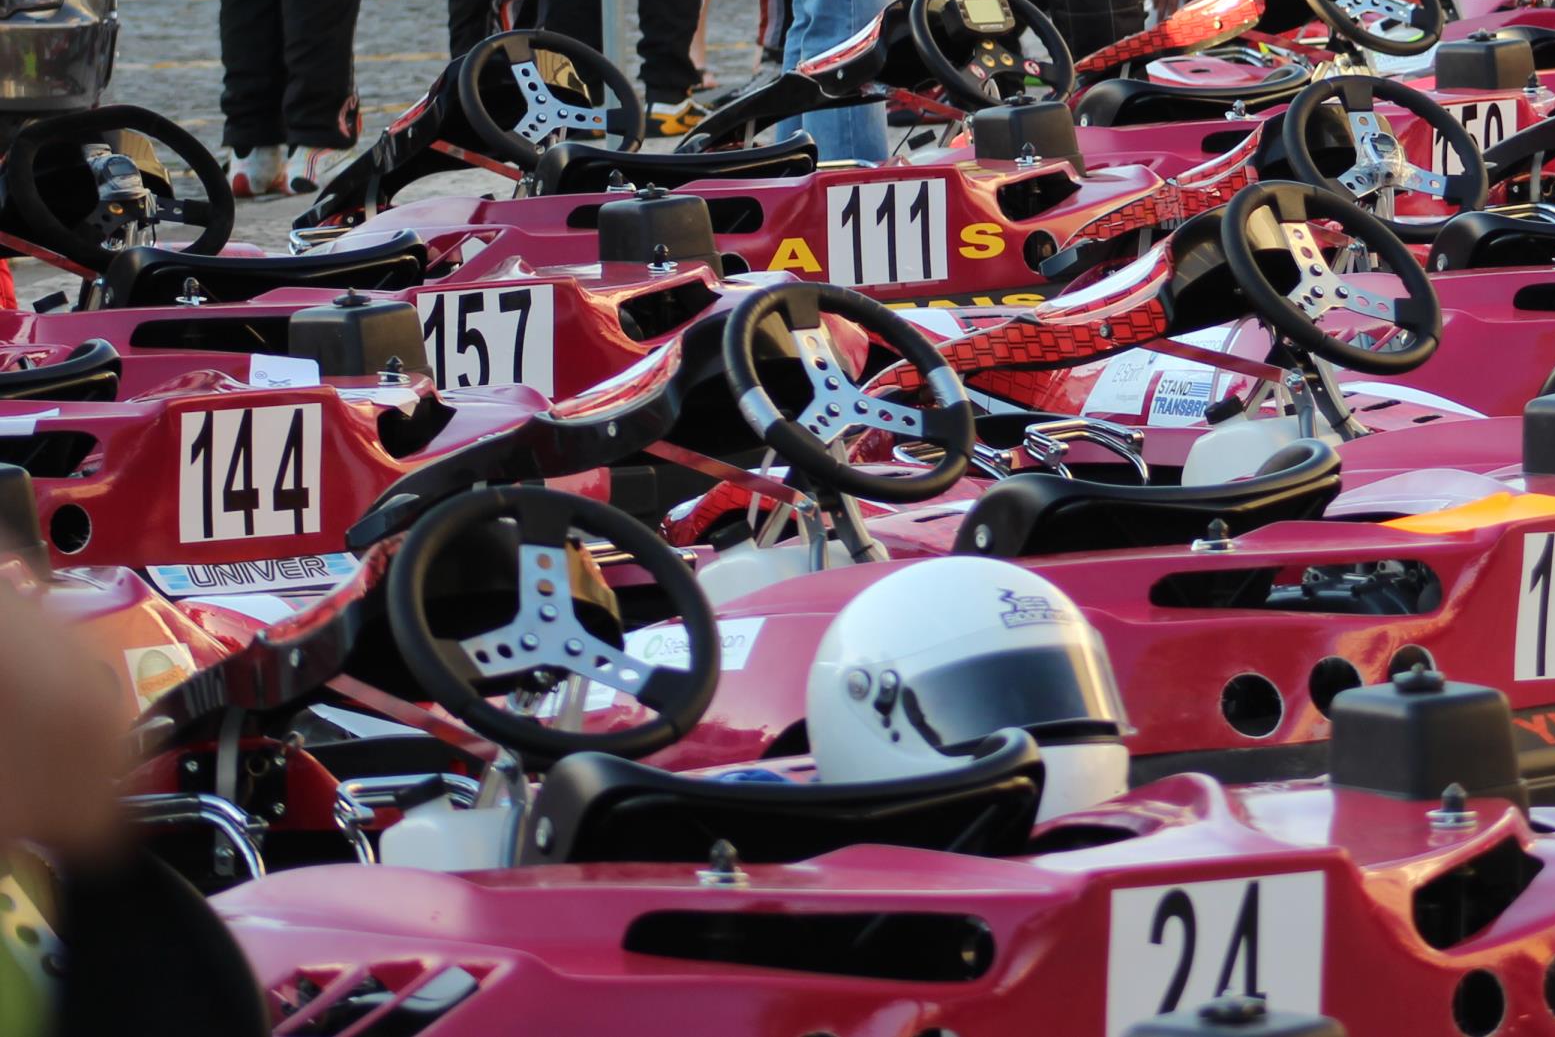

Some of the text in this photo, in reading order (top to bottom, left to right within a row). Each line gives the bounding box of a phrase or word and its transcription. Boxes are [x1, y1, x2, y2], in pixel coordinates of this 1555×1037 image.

[841, 180, 932, 285] 111
[423, 288, 532, 392] 157
[1158, 379, 1193, 396] STAND
[190, 408, 310, 539] 144
[186, 555, 329, 588] UNIVER
[1148, 880, 1267, 1015] 24
